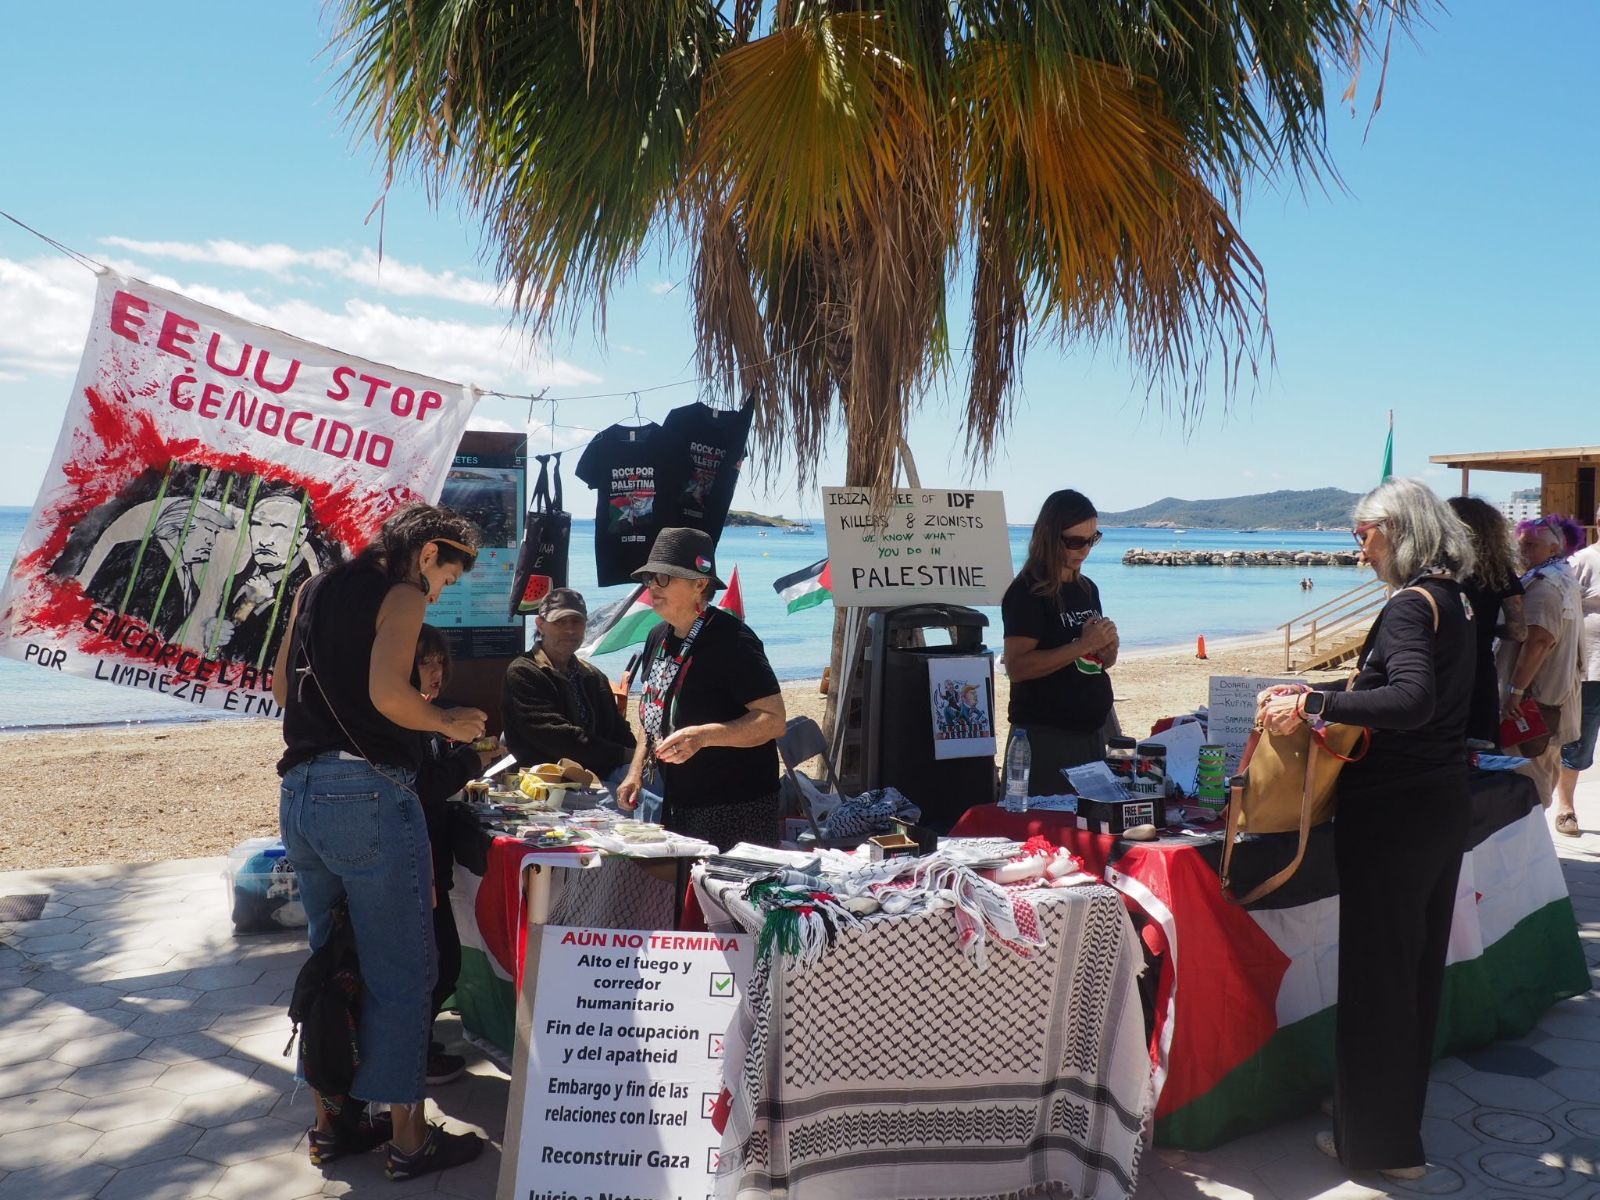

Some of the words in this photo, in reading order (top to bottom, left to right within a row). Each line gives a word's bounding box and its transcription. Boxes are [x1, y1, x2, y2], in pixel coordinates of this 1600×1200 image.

[327, 366, 443, 421] STOP
[169, 374, 394, 468] GENOCIDIO
[612, 468, 634, 478] ROCK
[635, 467, 654, 476] POR
[611, 480, 655, 490] PALESTINA
[829, 493, 869, 505] IBIZA
[922, 495, 935, 503] OF
[948, 493, 974, 508] IDF
[924, 515, 984, 528] ZIONISTS
[862, 534, 876, 542] WE
[883, 533, 914, 541] KNOW
[924, 533, 955, 541] WHAT
[878, 547, 899, 558] YOU
[931, 547, 941, 555] IN
[852, 566, 986, 589] PALESTINE
[84, 607, 273, 692] ENCARCELAD
[25, 643, 67, 671] POR
[95, 659, 207, 703] LIMPIEZA
[1224, 698, 1253, 708] KUFIYA
[1225, 726, 1252, 734] BOSSES
[1125, 806, 1136, 816] FREE
[1125, 816, 1153, 828] PALESTINE
[561, 930, 607, 947] AÚN
[612, 934, 644, 949] NO
[649, 936, 740, 952] TERMINA
[577, 955, 612, 968] Alto
[616, 956, 629, 969] el
[633, 957, 679, 974] fuego
[682, 961, 692, 974] y
[593, 977, 661, 991] corredor
[576, 996, 674, 1012] humanitario
[546, 1020, 571, 1035] Fin
[575, 1022, 595, 1036] de
[599, 1022, 613, 1037] la
[617, 1025, 700, 1042] ocupación
[562, 1048, 573, 1064] y
[577, 1046, 602, 1061] del
[605, 1049, 678, 1066] apatheid
[548, 1078, 611, 1100] Embargo
[614, 1083, 624, 1101] y
[626, 1080, 645, 1097] fin
[649, 1082, 666, 1098] de
[669, 1083, 688, 1099] las
[545, 1105, 616, 1124] relaciones
[620, 1112, 645, 1125] con
[649, 1109, 687, 1126] Israel
[541, 1146, 643, 1167] Reconstruir
[647, 1150, 690, 1168] Gaza
